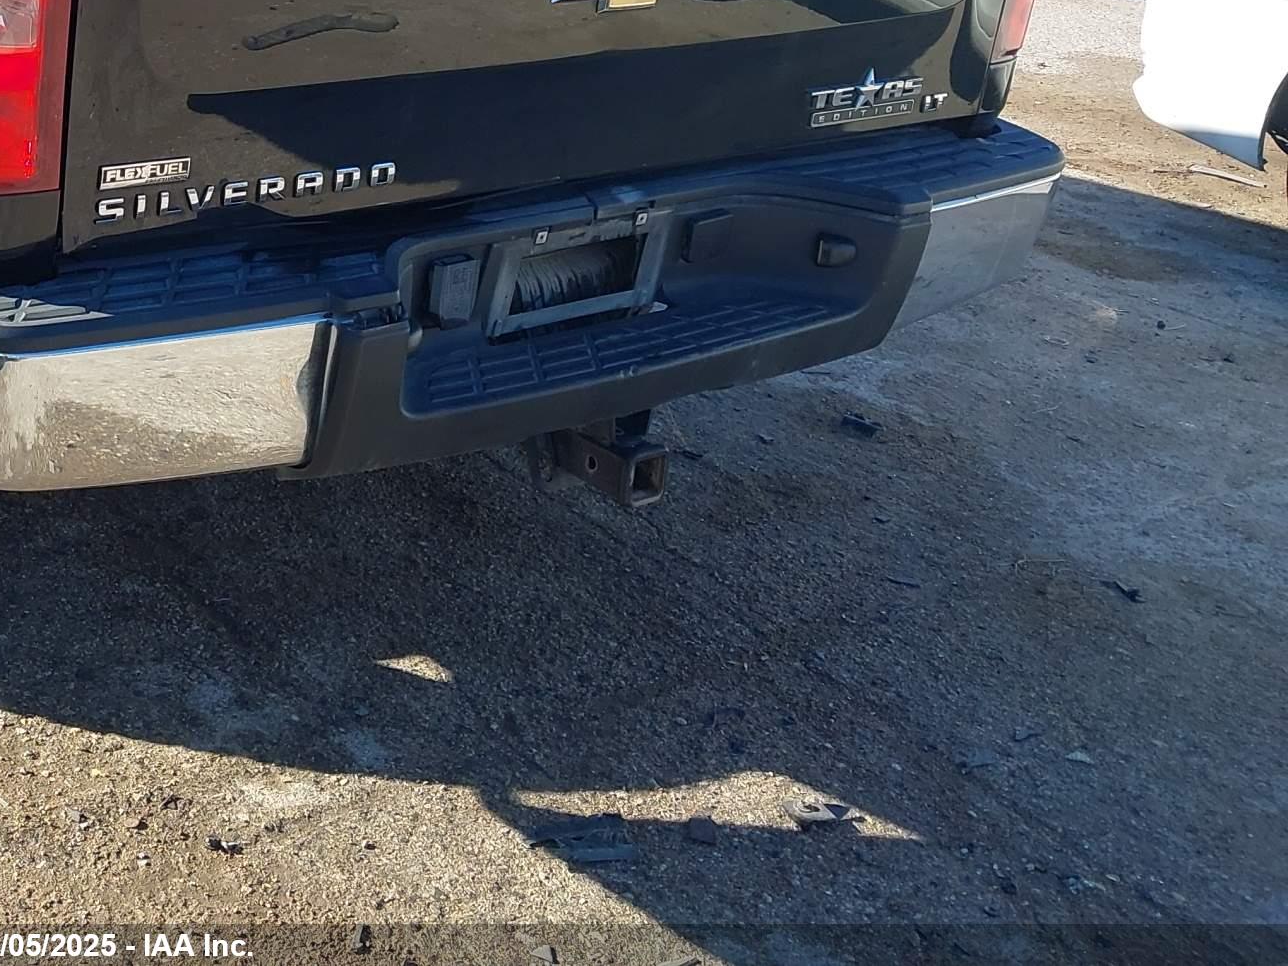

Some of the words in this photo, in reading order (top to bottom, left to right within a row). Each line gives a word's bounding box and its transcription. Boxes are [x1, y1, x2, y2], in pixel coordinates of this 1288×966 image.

[811, 68, 924, 111] TEXAS
[818, 103, 909, 123] EDITION
[95, 161, 397, 224] SILVERADO
